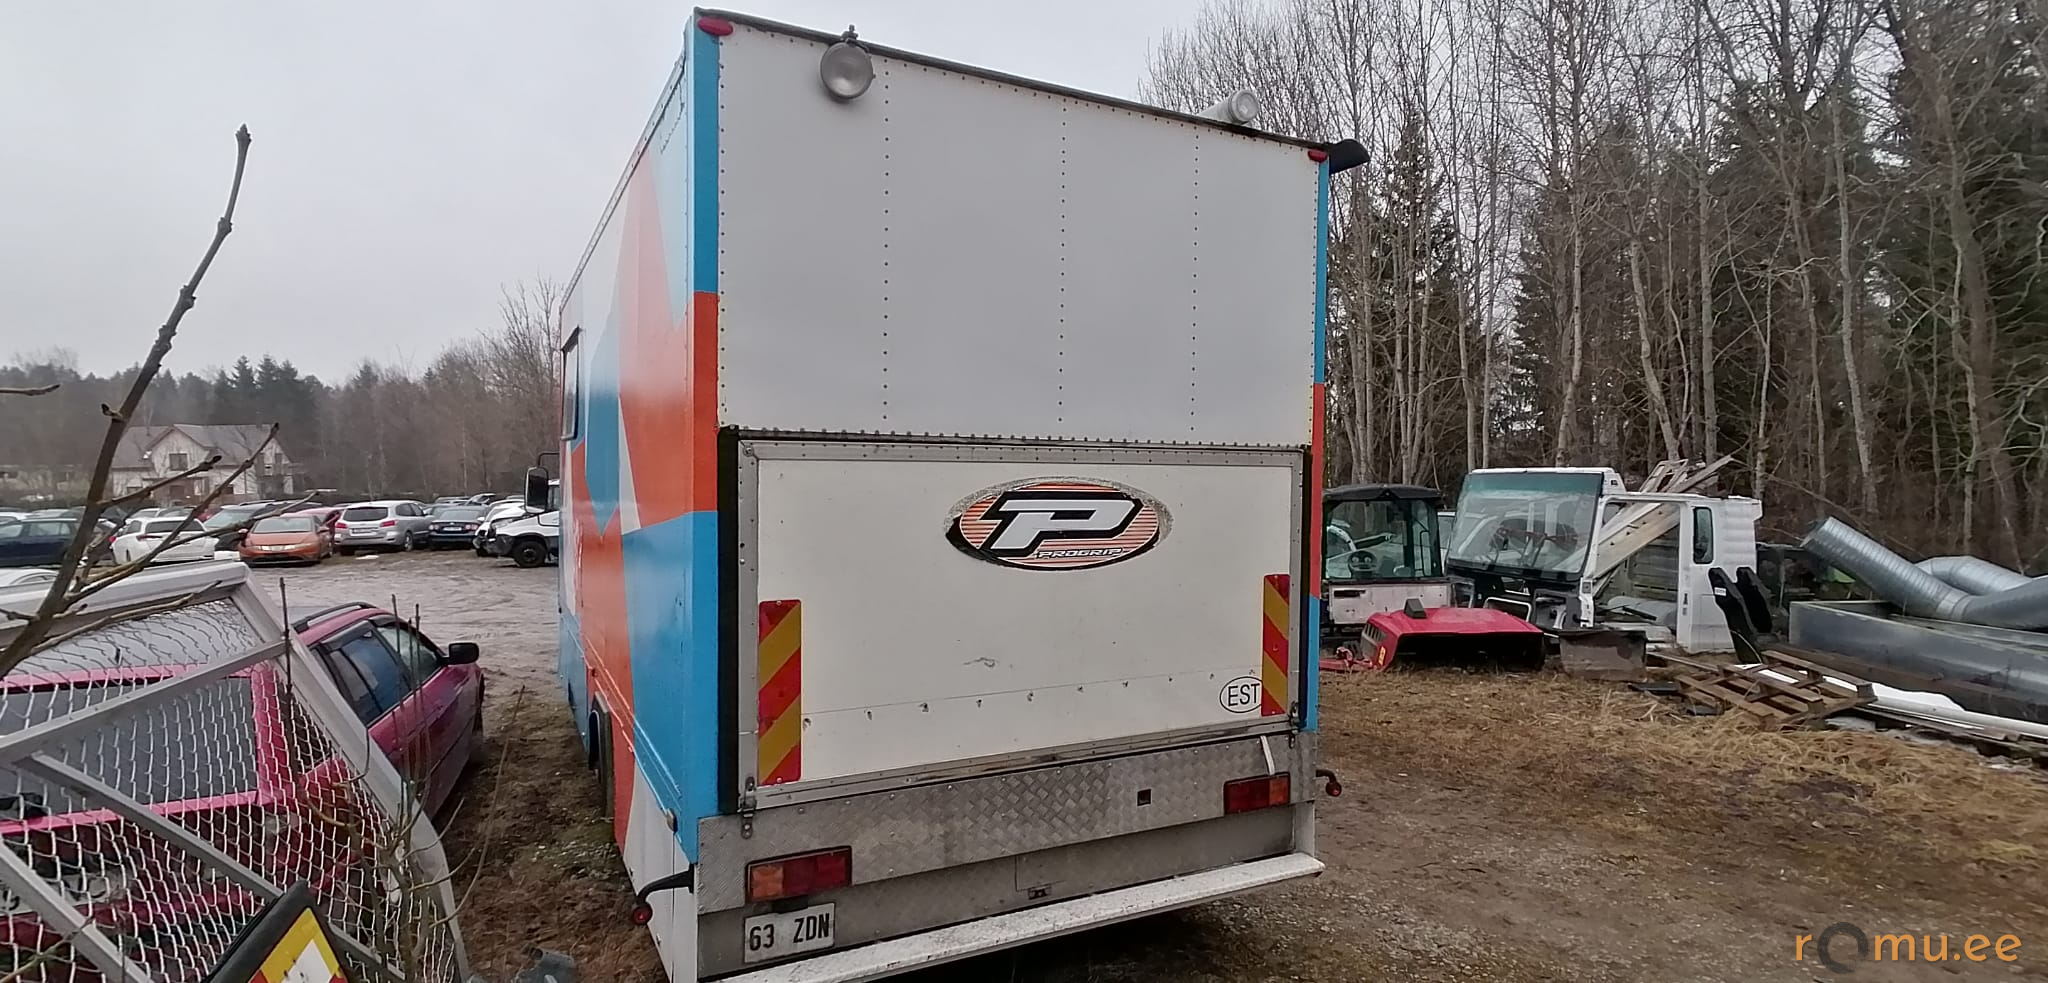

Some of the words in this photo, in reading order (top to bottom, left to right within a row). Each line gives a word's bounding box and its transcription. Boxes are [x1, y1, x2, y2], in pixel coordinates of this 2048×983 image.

[987, 497, 1138, 552] P
[1037, 547, 1122, 560] PROGRIP
[1227, 682, 1261, 707] EST
[749, 923, 775, 952] 63
[793, 912, 830, 944] ZDN
